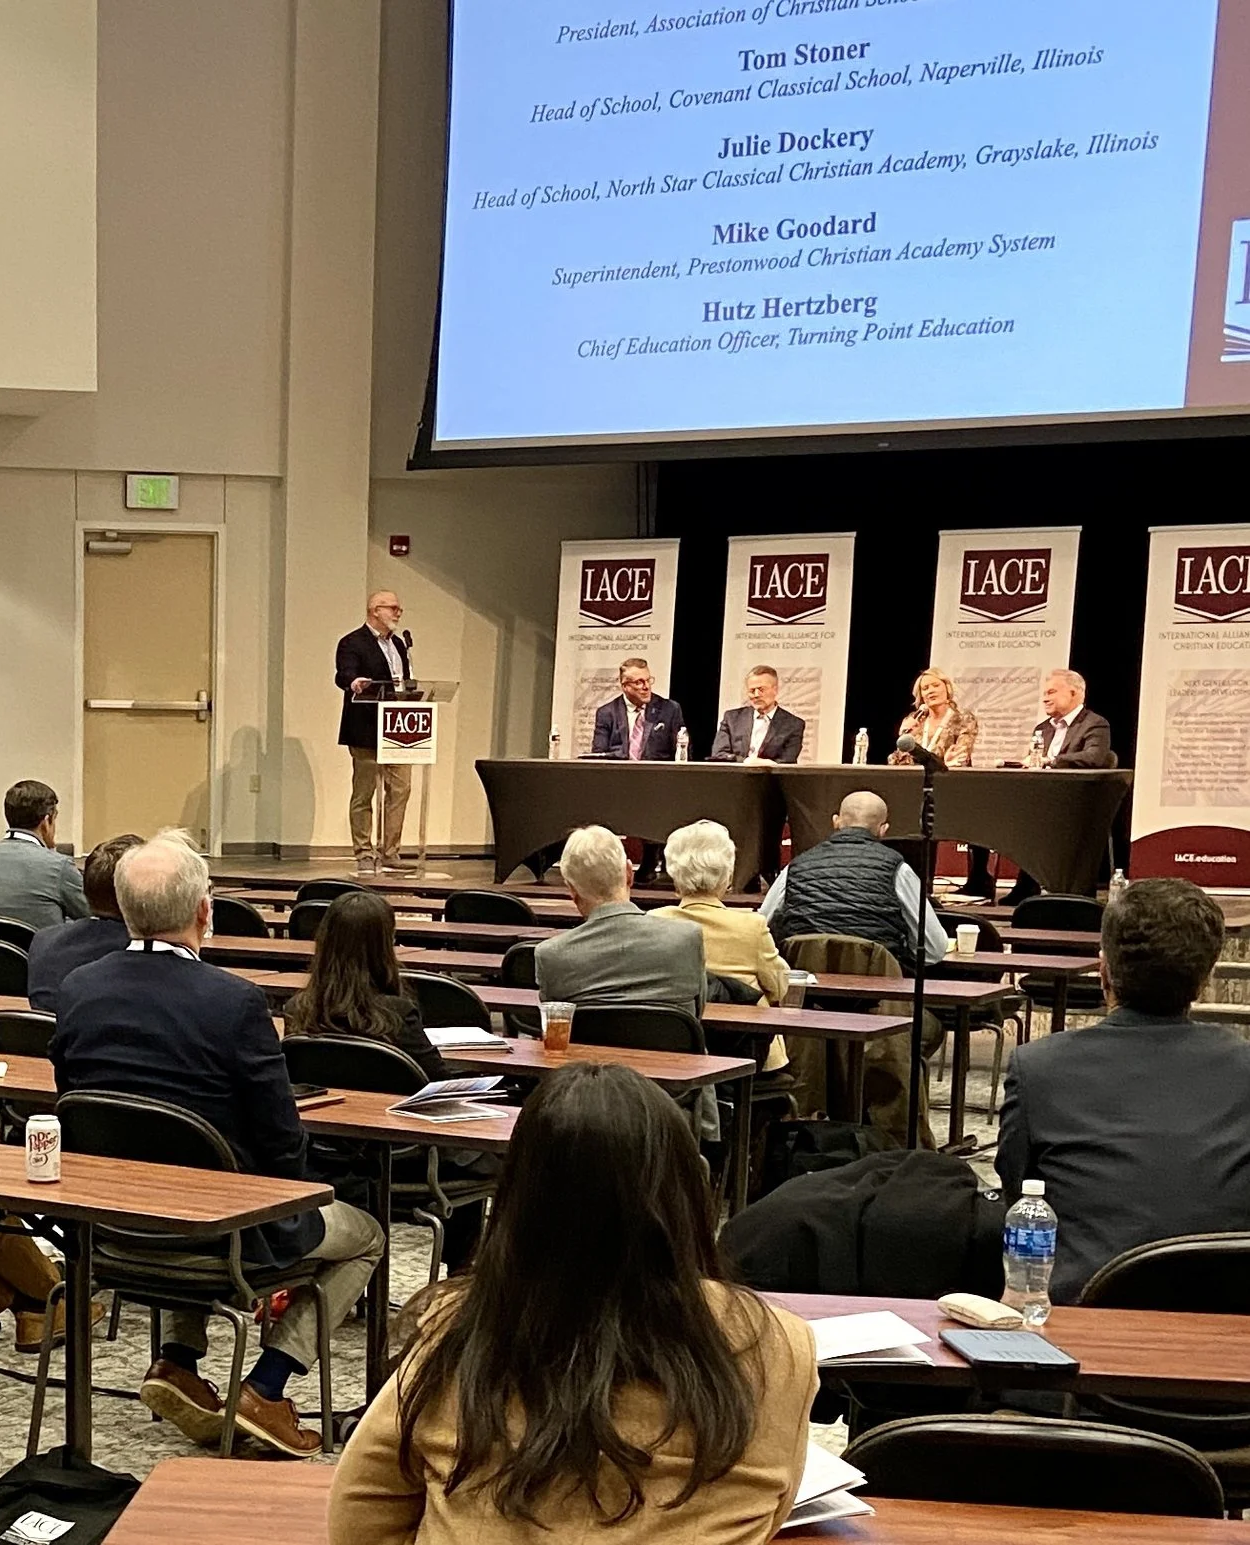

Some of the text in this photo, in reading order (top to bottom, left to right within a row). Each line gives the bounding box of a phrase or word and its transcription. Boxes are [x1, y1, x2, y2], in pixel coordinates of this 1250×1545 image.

[556, 20, 639, 44] President,
[644, 7, 746, 34] Association
[751, 0, 775, 25] of
[738, 42, 871, 72] Tom Stoner
[530, 45, 1104, 123] Head of School, Covenant Classical School, Naperville, Illinois
[718, 127, 875, 160] Julie Dockery
[471, 131, 1160, 210] Head of School, North Star Classical Christian Academy, Grayslake, Illinois
[712, 212, 877, 246] Mike Goodard
[552, 233, 1056, 288] Superintendent, Prestonwood Christian Academy System
[701, 294, 879, 323] Hutz Hertzberg
[577, 316, 1015, 360] Chief Education Officer, Turning Point Education
[583, 567, 651, 601] IACE
[751, 562, 825, 598] IACE
[964, 558, 1046, 595] IACE
[1041, 629, 1057, 638] FOR
[1158, 631, 1220, 640] INTERNATIONAL
[1173, 642, 1214, 651] CHRISTIAN
[385, 712, 430, 733] IACE
[1174, 853, 1237, 863] IACE.education
